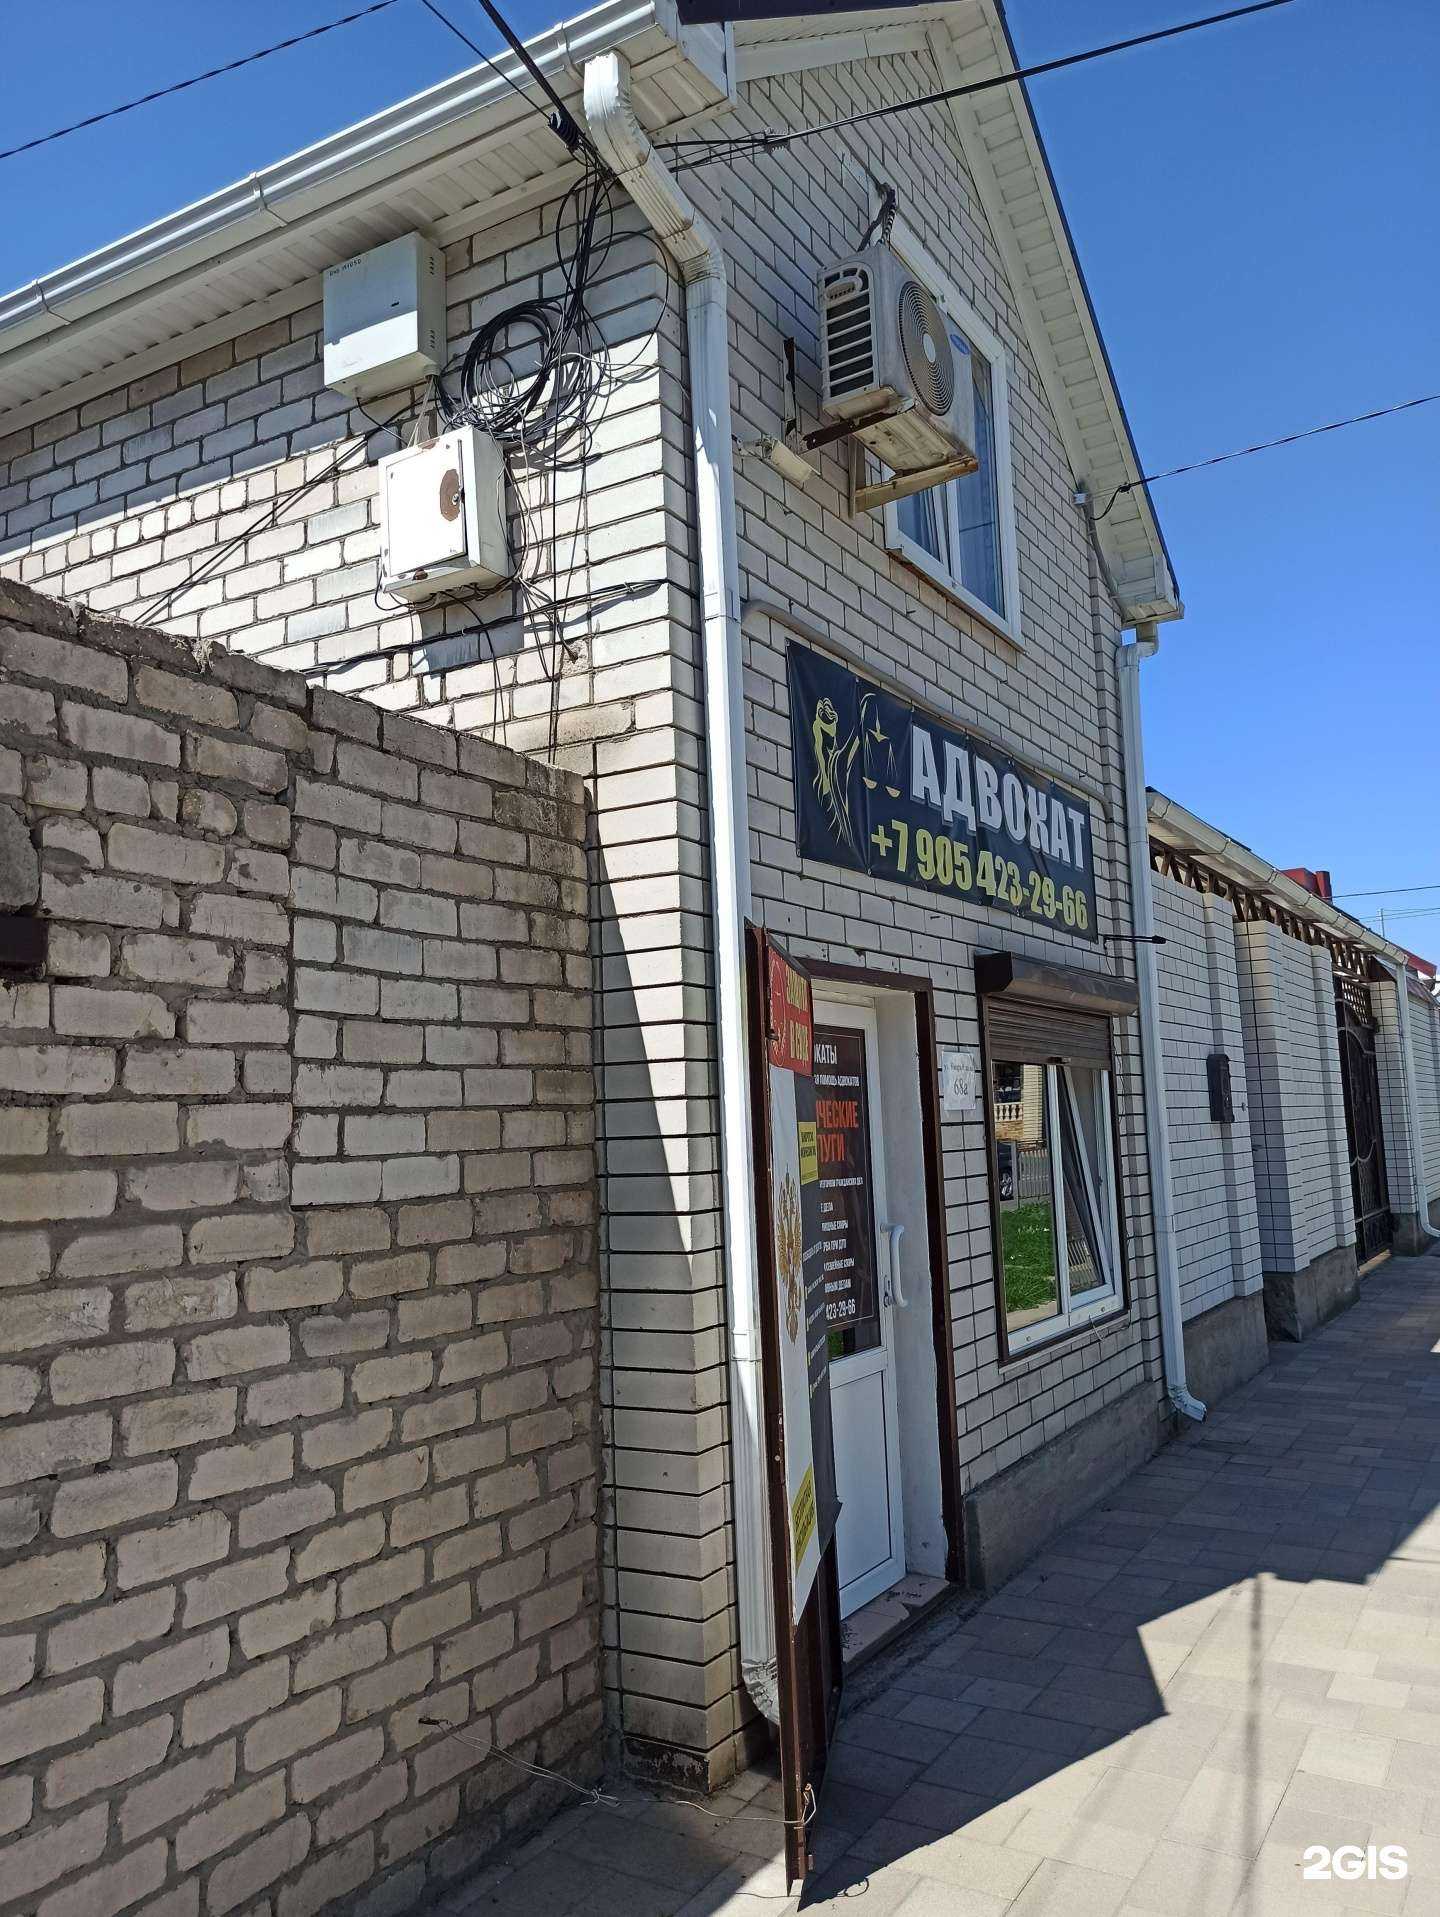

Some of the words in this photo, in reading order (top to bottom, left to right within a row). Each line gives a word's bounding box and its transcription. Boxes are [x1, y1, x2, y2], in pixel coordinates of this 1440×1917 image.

[911, 725, 1085, 871] АДВОКАТ
[871, 820, 908, 873] +7
[916, 827, 973, 892] 905
[976, 850, 1088, 930] 423-29-66
